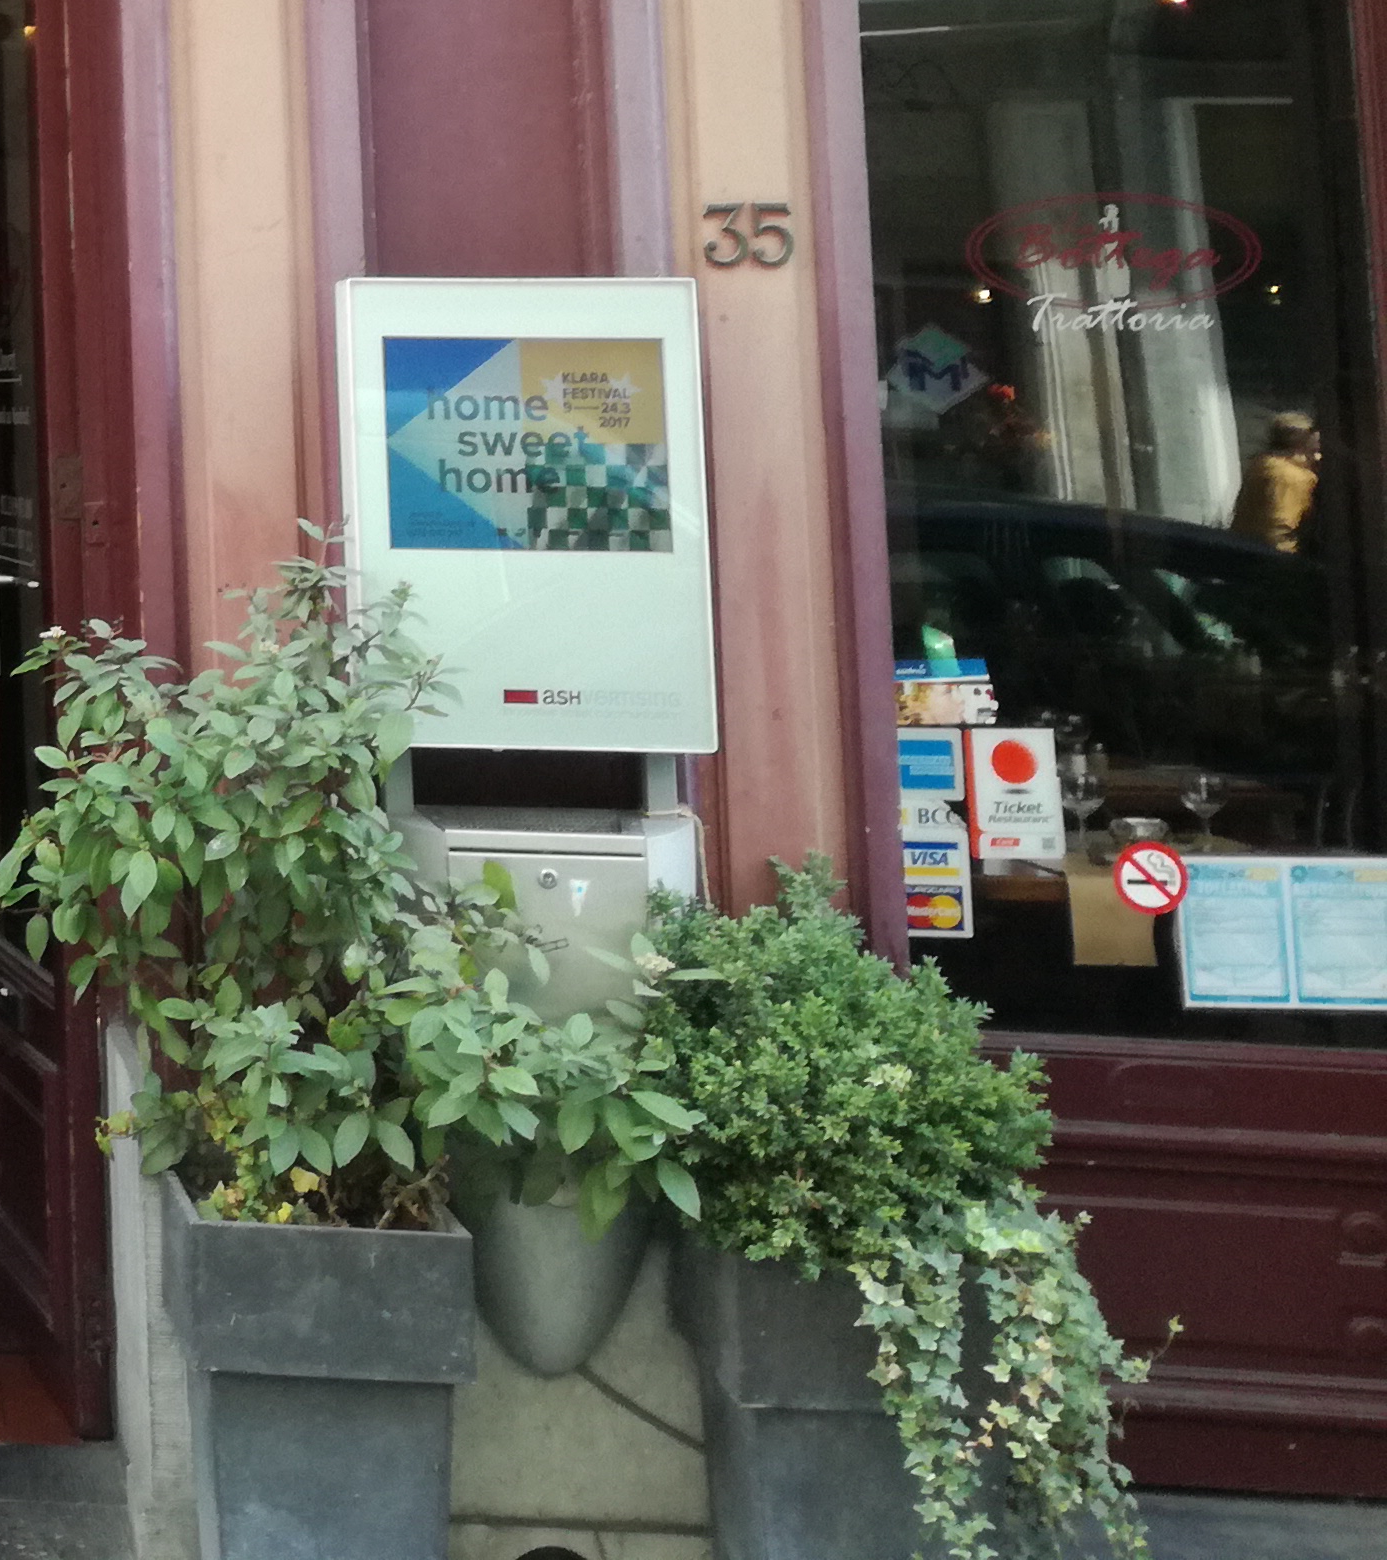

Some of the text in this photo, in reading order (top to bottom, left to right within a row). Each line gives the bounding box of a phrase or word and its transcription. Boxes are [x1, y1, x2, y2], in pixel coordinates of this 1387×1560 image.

[702, 201, 795, 267] 35
[1010, 223, 1222, 292] Bottega
[1026, 292, 1215, 333] Trattoria
[562, 371, 610, 384] KLARA
[427, 384, 549, 421] home
[562, 387, 630, 400] FESTIVAL
[598, 416, 631, 429] 2017
[457, 426, 590, 456] sweet
[438, 458, 561, 494] home
[994, 801, 1043, 814] Ticket
[910, 851, 950, 866] VISA
